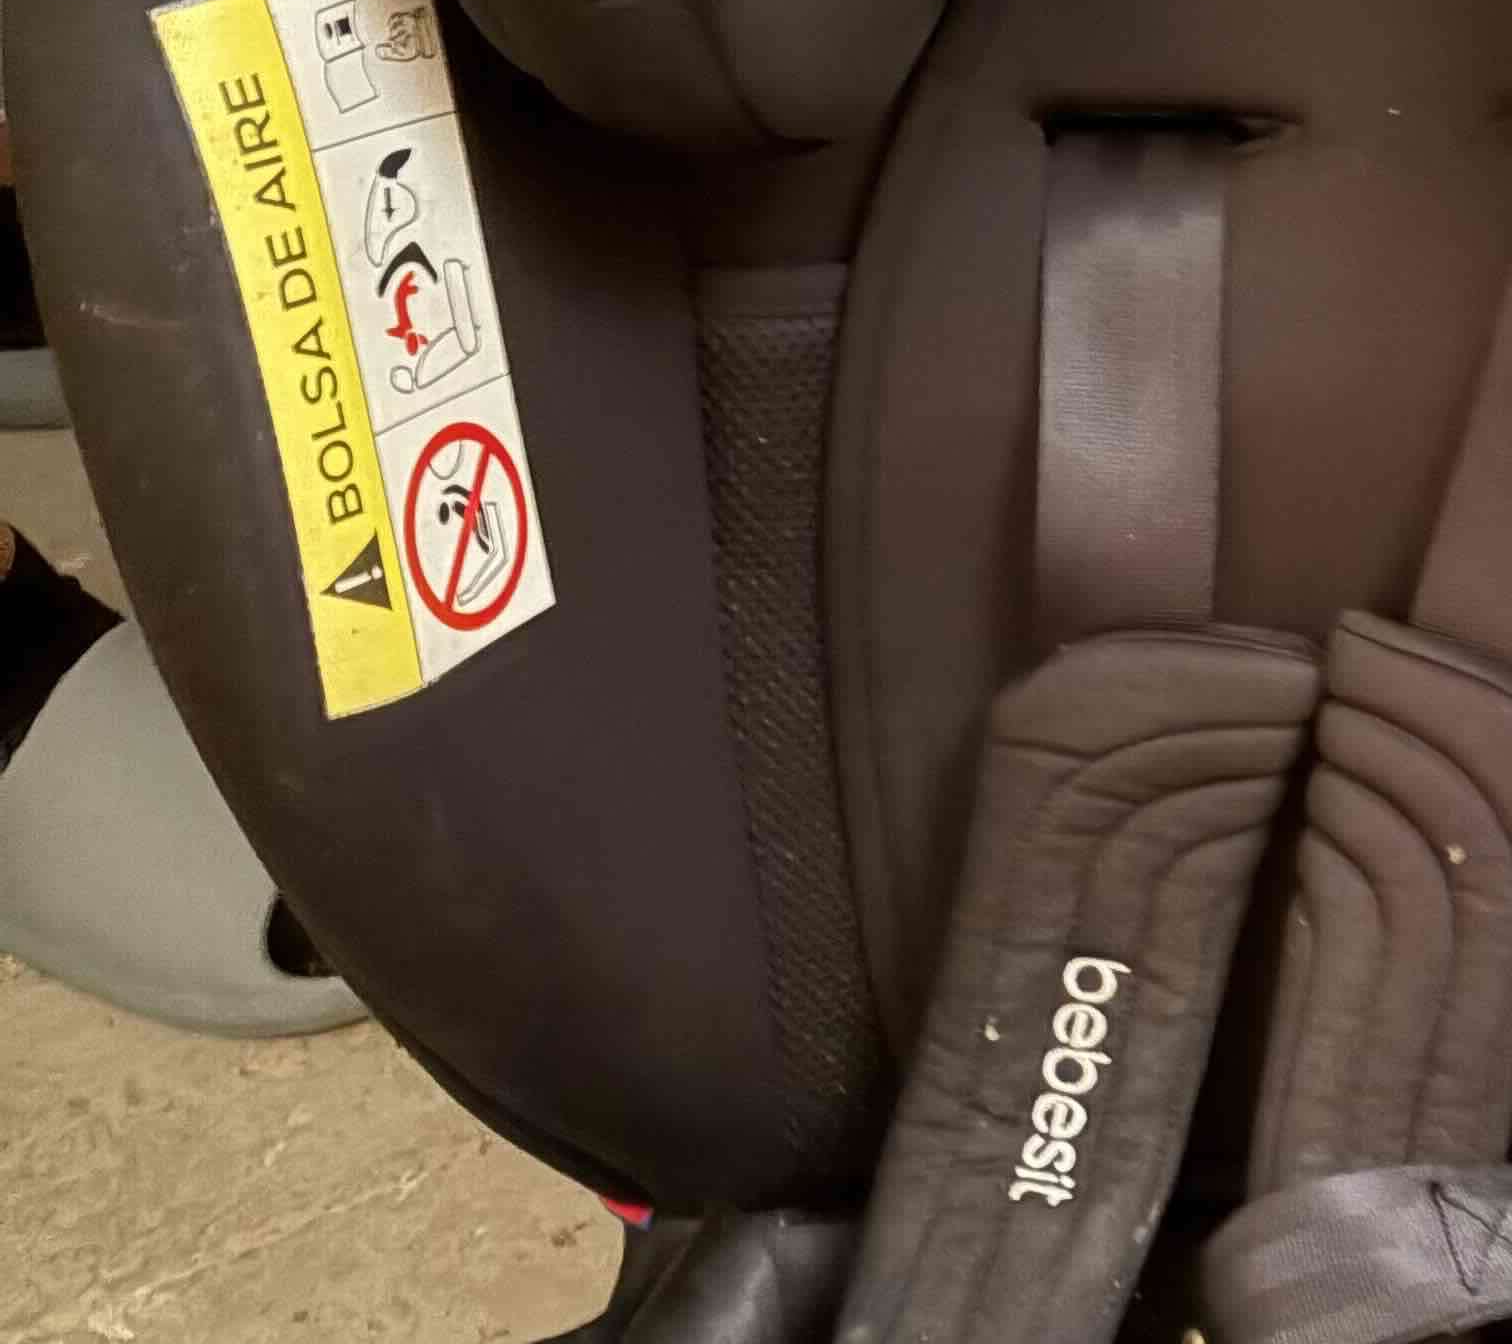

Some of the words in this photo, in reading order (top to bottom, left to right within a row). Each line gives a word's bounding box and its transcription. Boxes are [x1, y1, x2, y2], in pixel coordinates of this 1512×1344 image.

[218, 72, 296, 212] AIRE
[265, 226, 317, 312] DE
[291, 316, 364, 524] BOLSA
[1008, 957, 1132, 1207] bebesit
